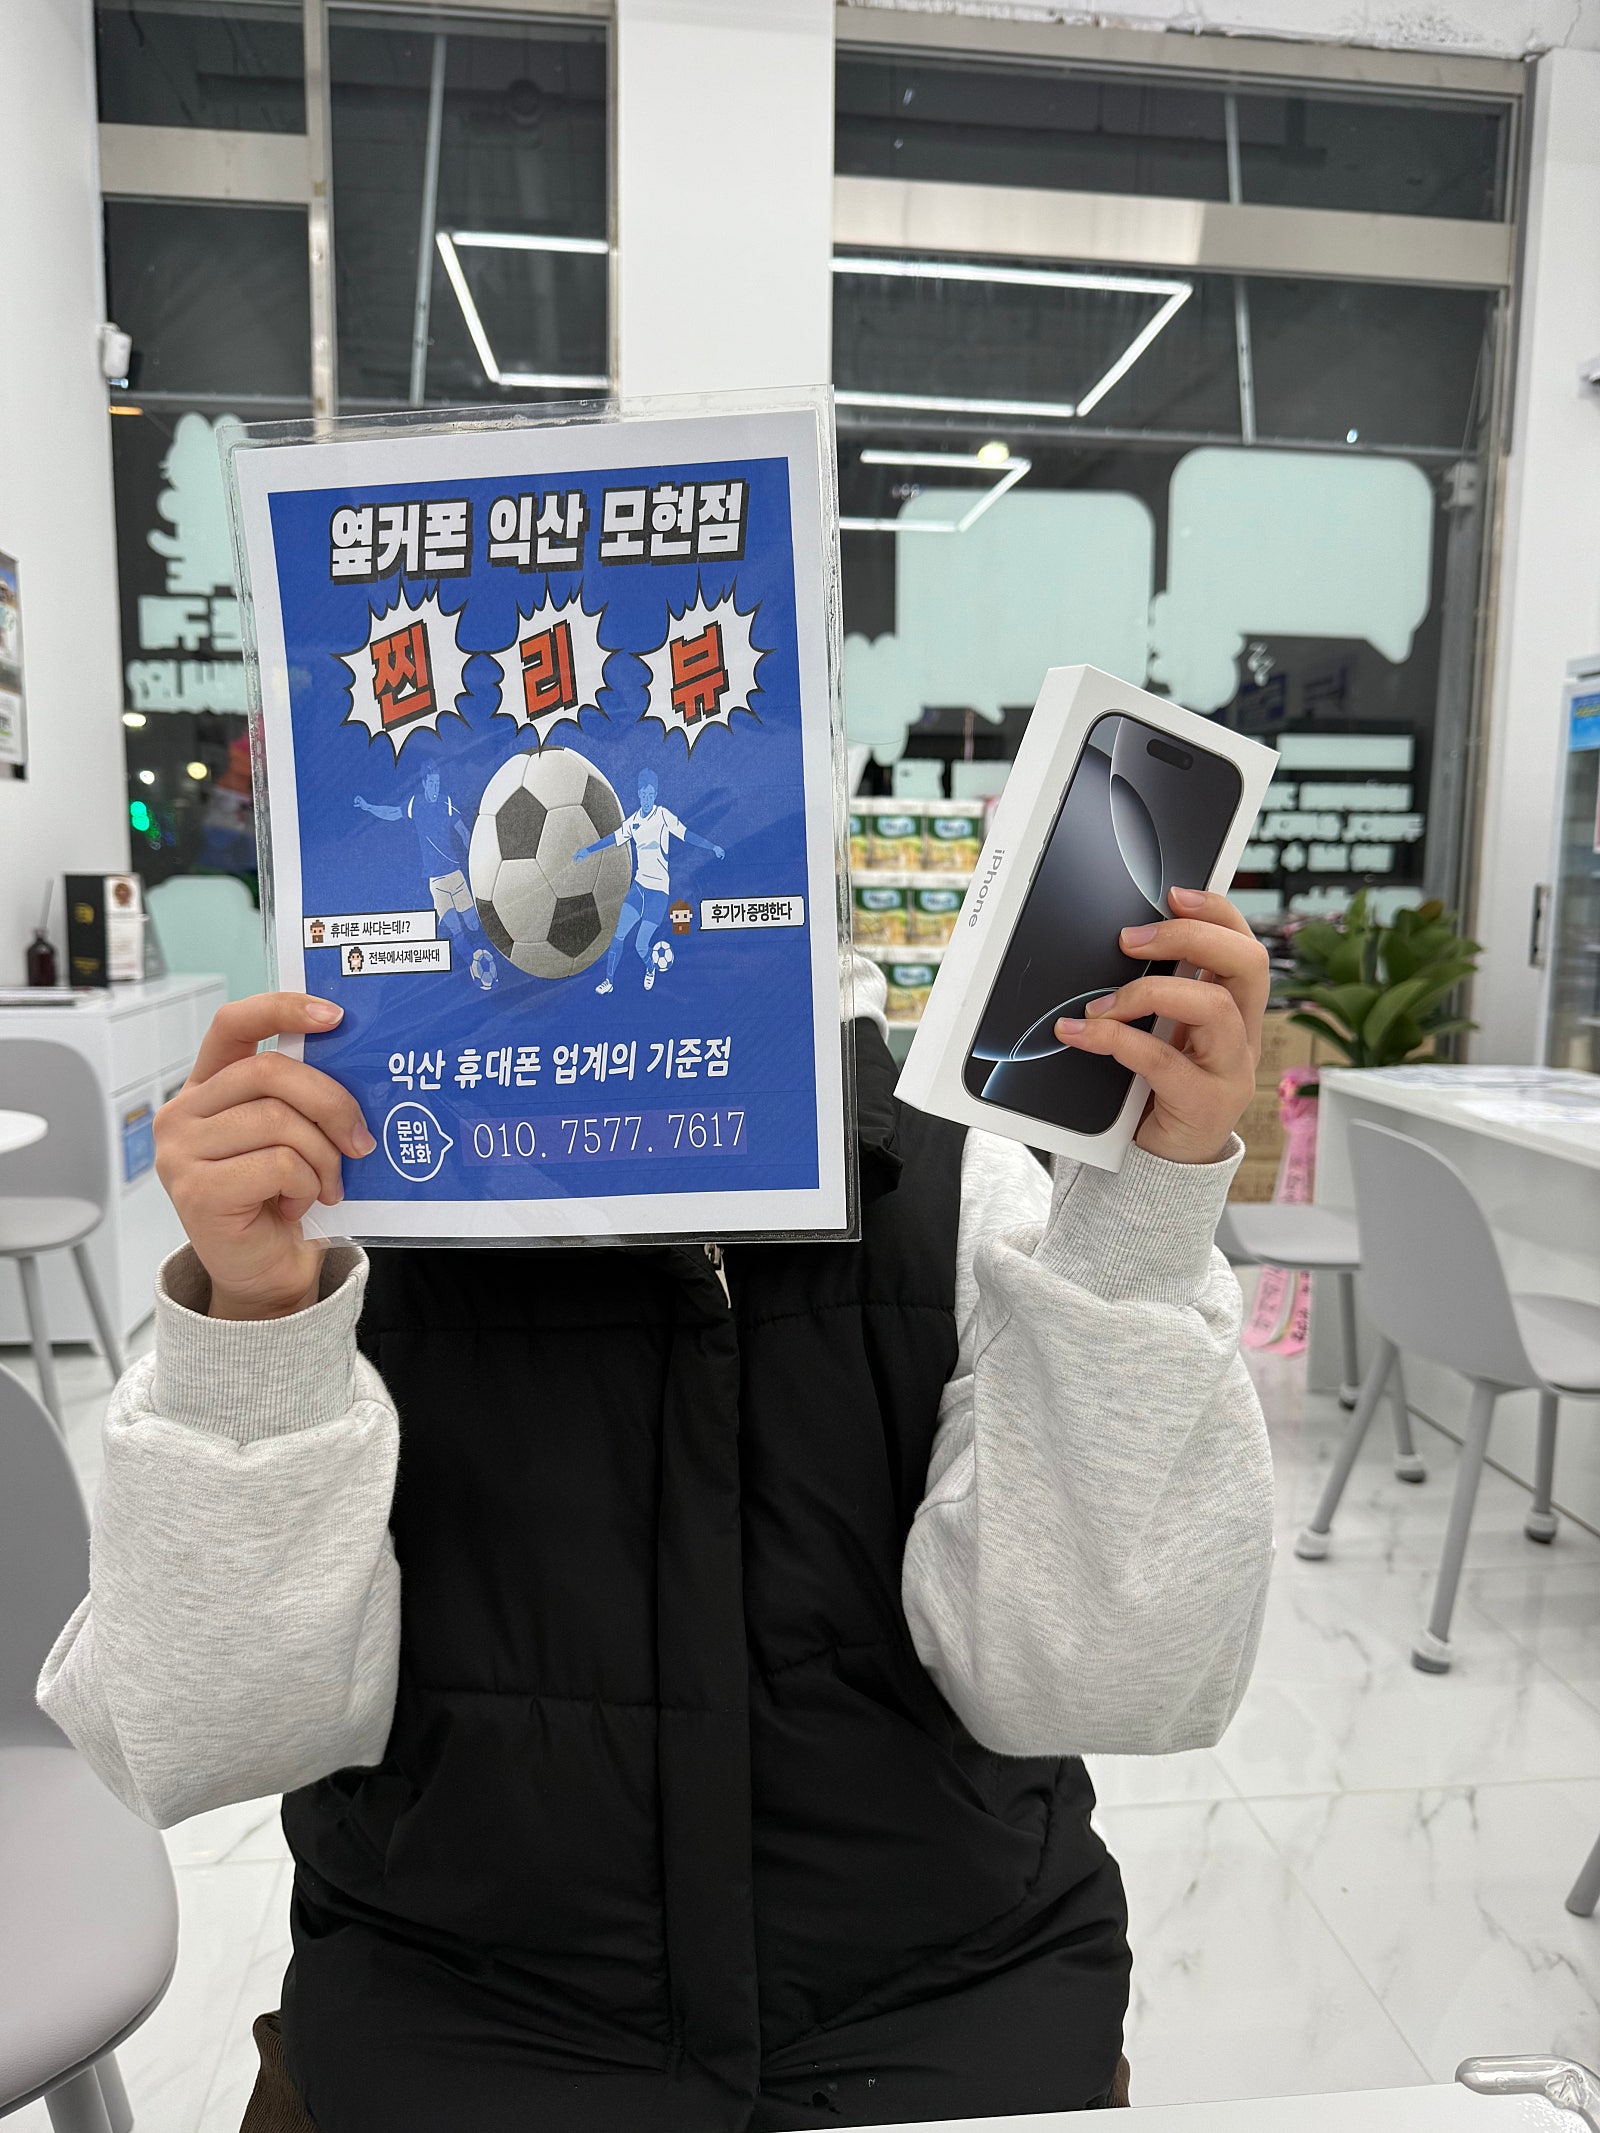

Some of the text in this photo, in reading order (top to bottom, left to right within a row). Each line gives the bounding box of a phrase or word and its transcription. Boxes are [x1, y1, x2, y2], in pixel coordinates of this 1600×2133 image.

[331, 480, 746, 580] 옆커폰 익산 모현점
[369, 621, 434, 728] 찐
[968, 849, 1006, 927] iPhone
[330, 920, 411, 938] 휴대폰 싸다는데!?
[388, 1036, 732, 1091] 익산 휴대폰 업계의 기준점
[396, 1120, 428, 1142] 문의
[400, 1143, 432, 1164] 전화
[474, 1111, 745, 1159] 010. 7577. 7617
